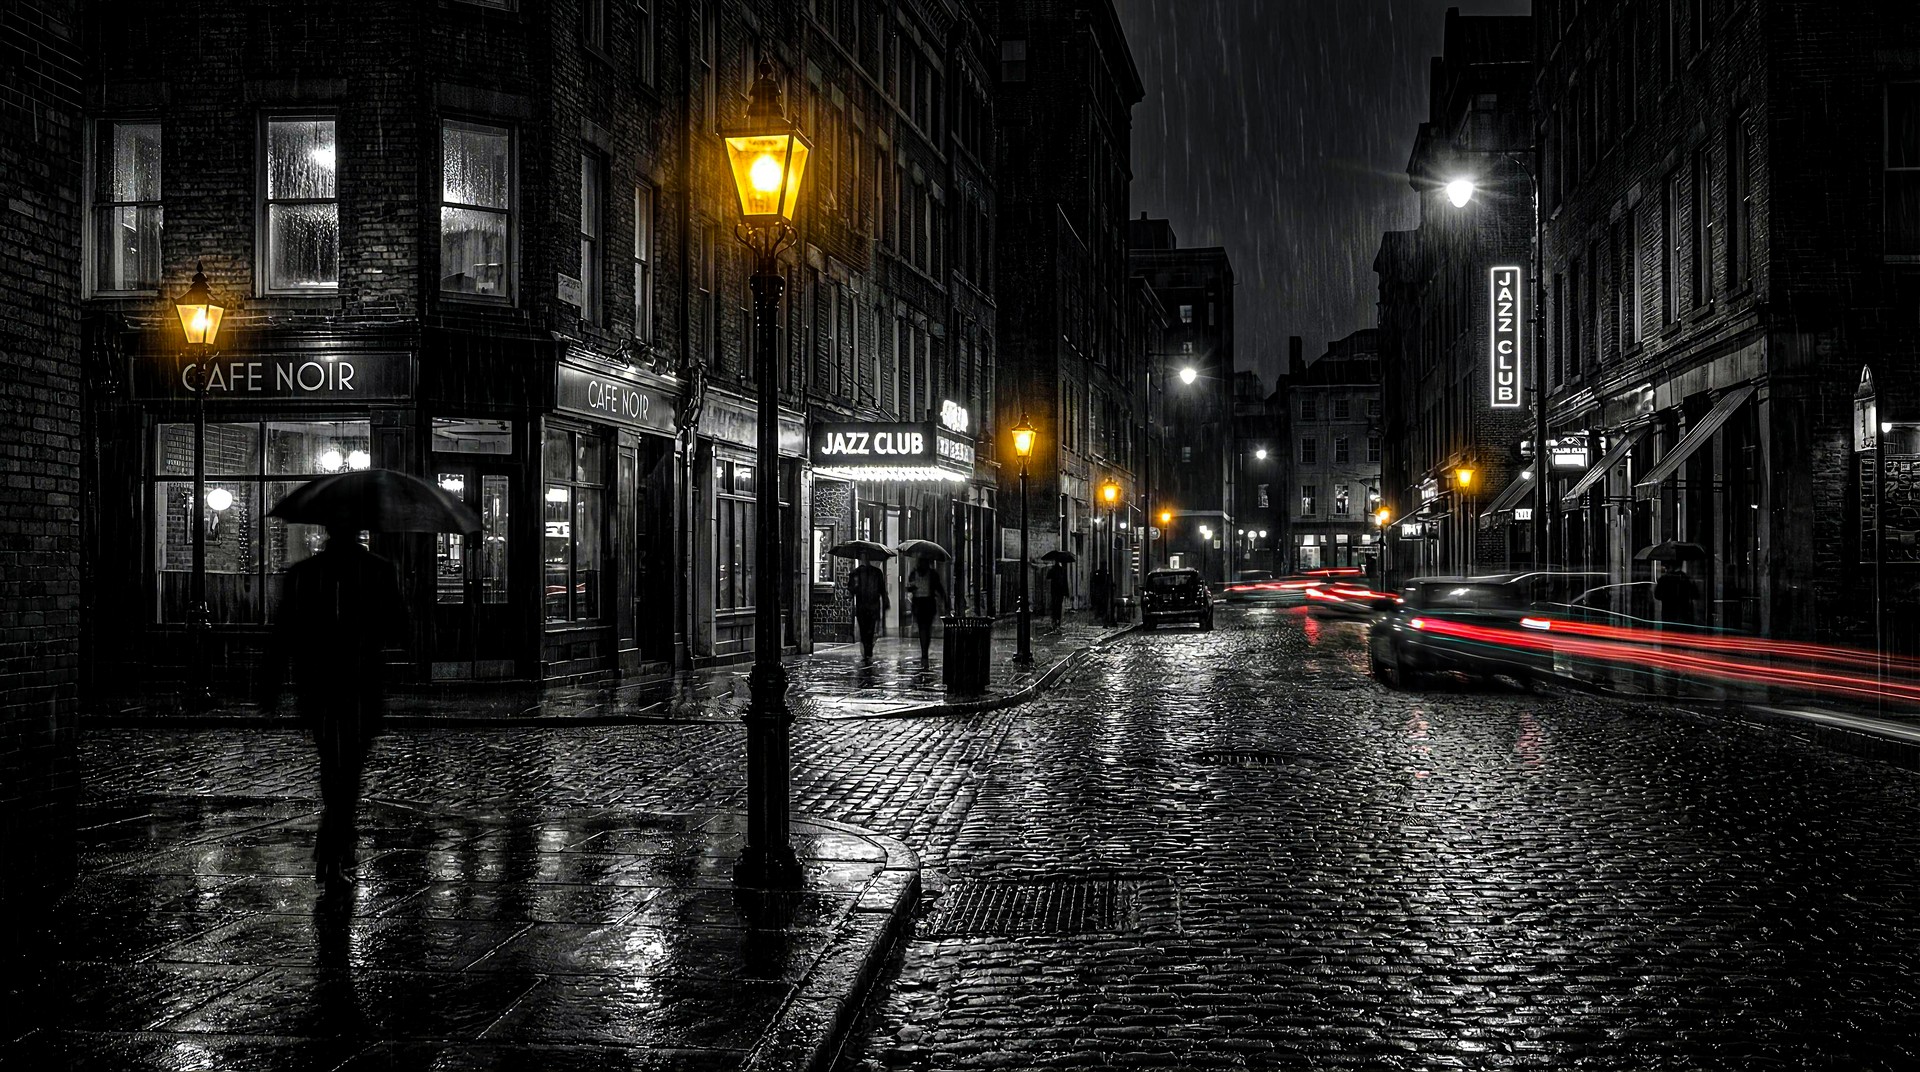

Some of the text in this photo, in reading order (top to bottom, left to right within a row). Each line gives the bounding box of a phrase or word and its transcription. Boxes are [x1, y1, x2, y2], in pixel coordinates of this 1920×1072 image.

[1497, 272, 1514, 401] JAZZ CLUB
[182, 361, 355, 392] CAFE NOIR
[588, 380, 649, 421] CAFE NOIR
[821, 432, 870, 455] JAZZ
[873, 432, 924, 455] CLUB
